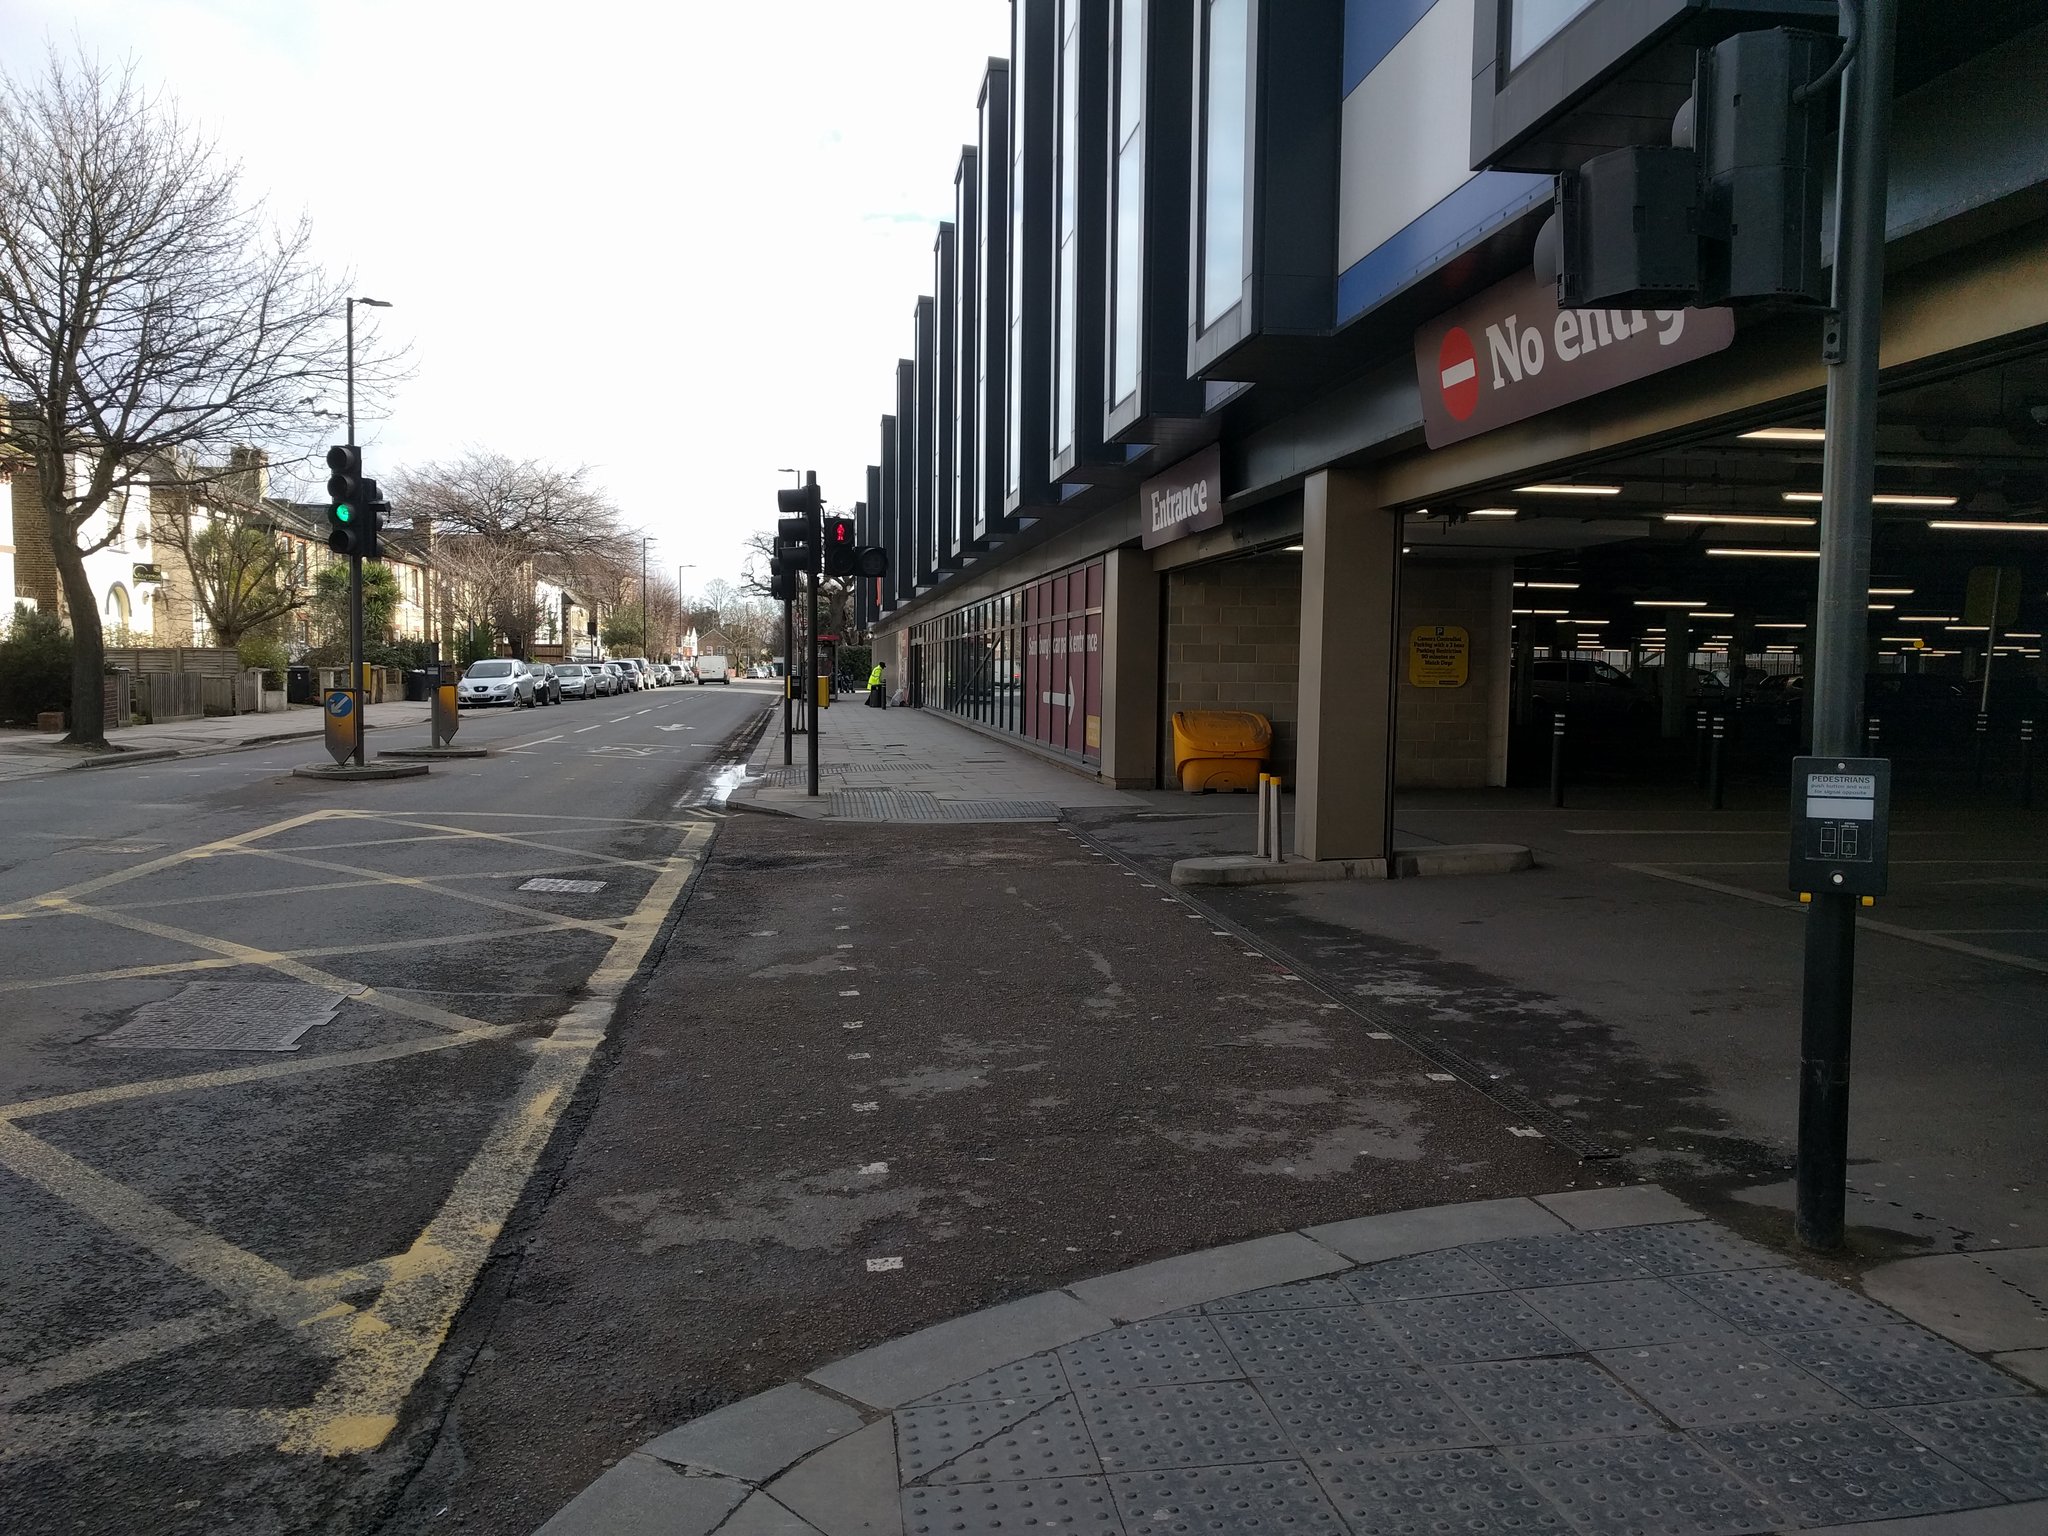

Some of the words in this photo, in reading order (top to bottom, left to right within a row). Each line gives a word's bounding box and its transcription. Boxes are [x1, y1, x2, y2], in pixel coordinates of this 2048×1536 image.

[1485, 313, 1545, 390] No
[1150, 479, 1208, 532] Entrance
[1028, 634, 1051, 660] Sainbury's
[1060, 629, 1073, 660] pak
[1073, 630, 1098, 653] entrnce
[1811, 775, 1871, 783] PEDESTRIANS
